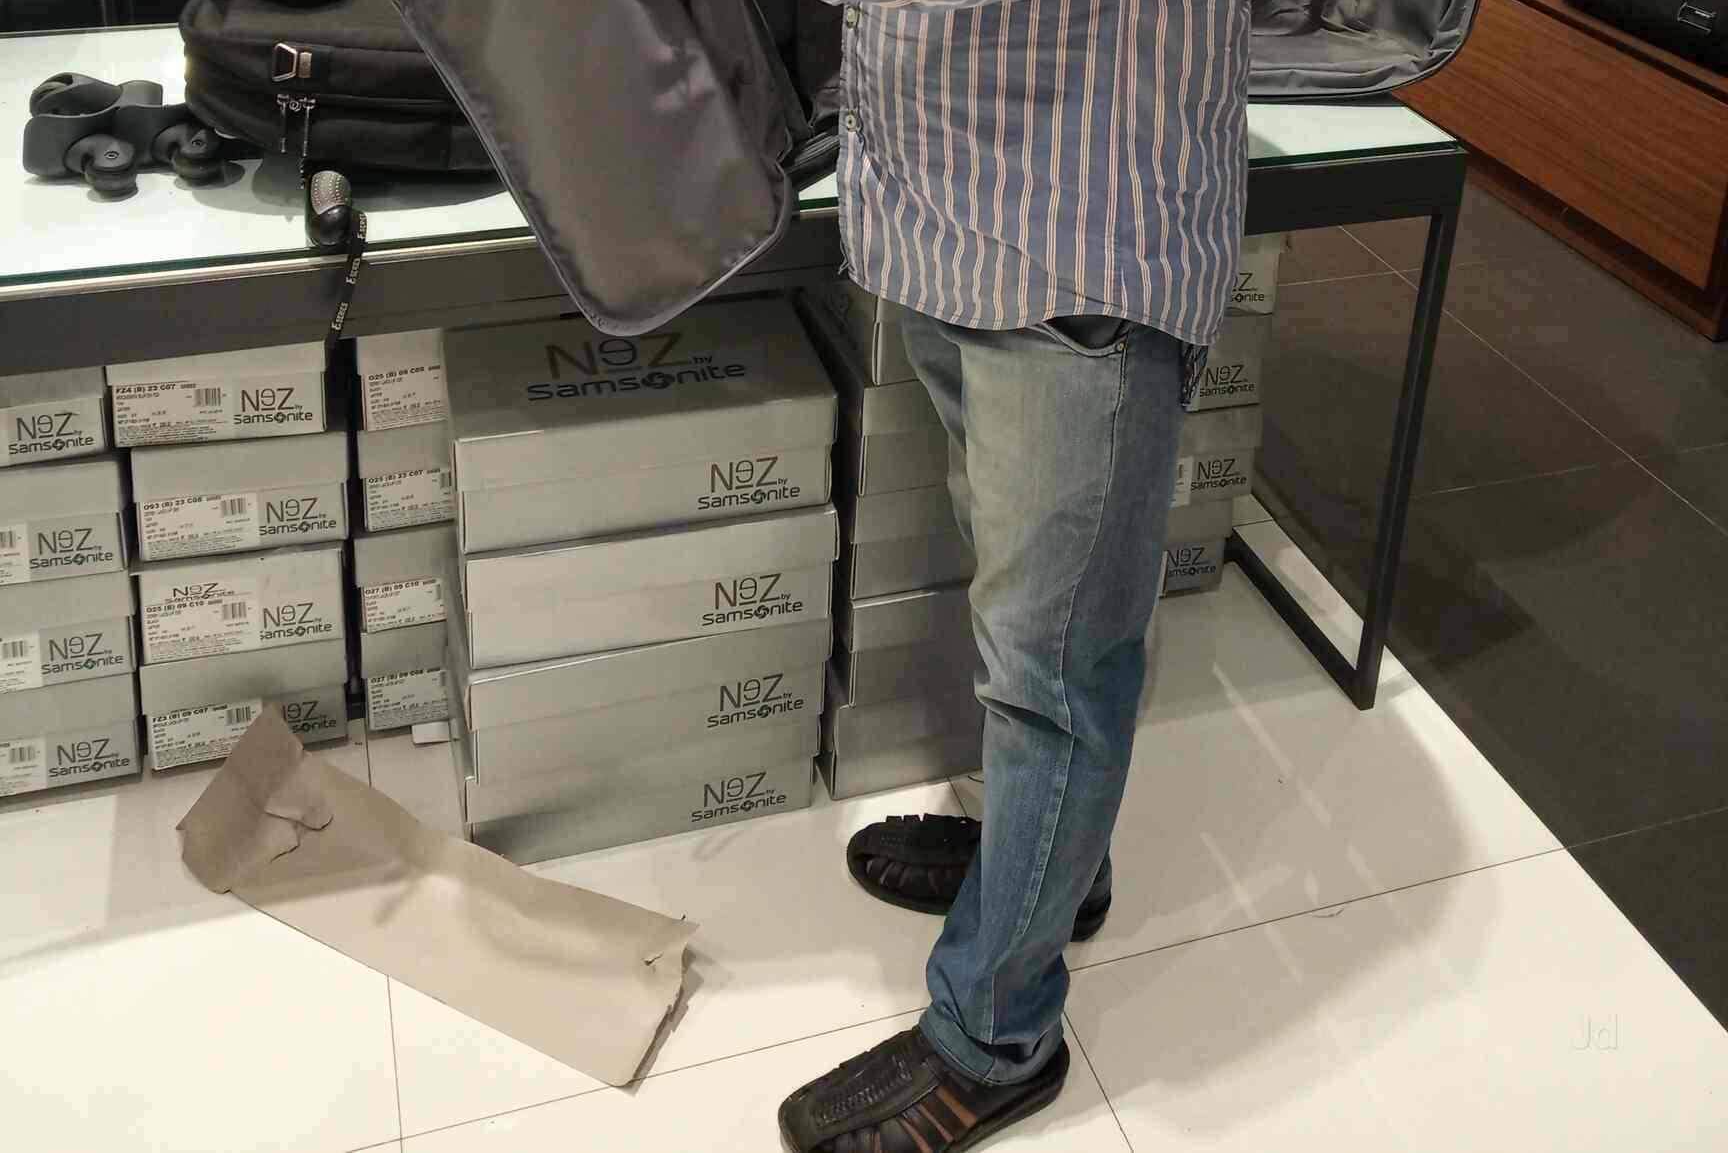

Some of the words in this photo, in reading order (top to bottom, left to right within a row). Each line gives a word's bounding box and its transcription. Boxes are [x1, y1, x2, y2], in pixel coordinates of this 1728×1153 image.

[527, 363, 745, 402] Samsonite
[1199, 381, 1257, 398] Samsonite
[233, 410, 313, 425] Samsonite
[8, 436, 95, 455] Samsonite
[1190, 475, 1248, 492] Samsonite
[697, 485, 801, 511] Samsonite
[258, 518, 337, 536] Samsonite
[29, 552, 114, 569] Samsonite
[701, 600, 804, 627] Samsonite
[41, 654, 125, 675] Samsonite
[706, 697, 805, 729] Samsonite
[48, 757, 131, 778] Samsonite
[690, 794, 788, 823] Samsonite
